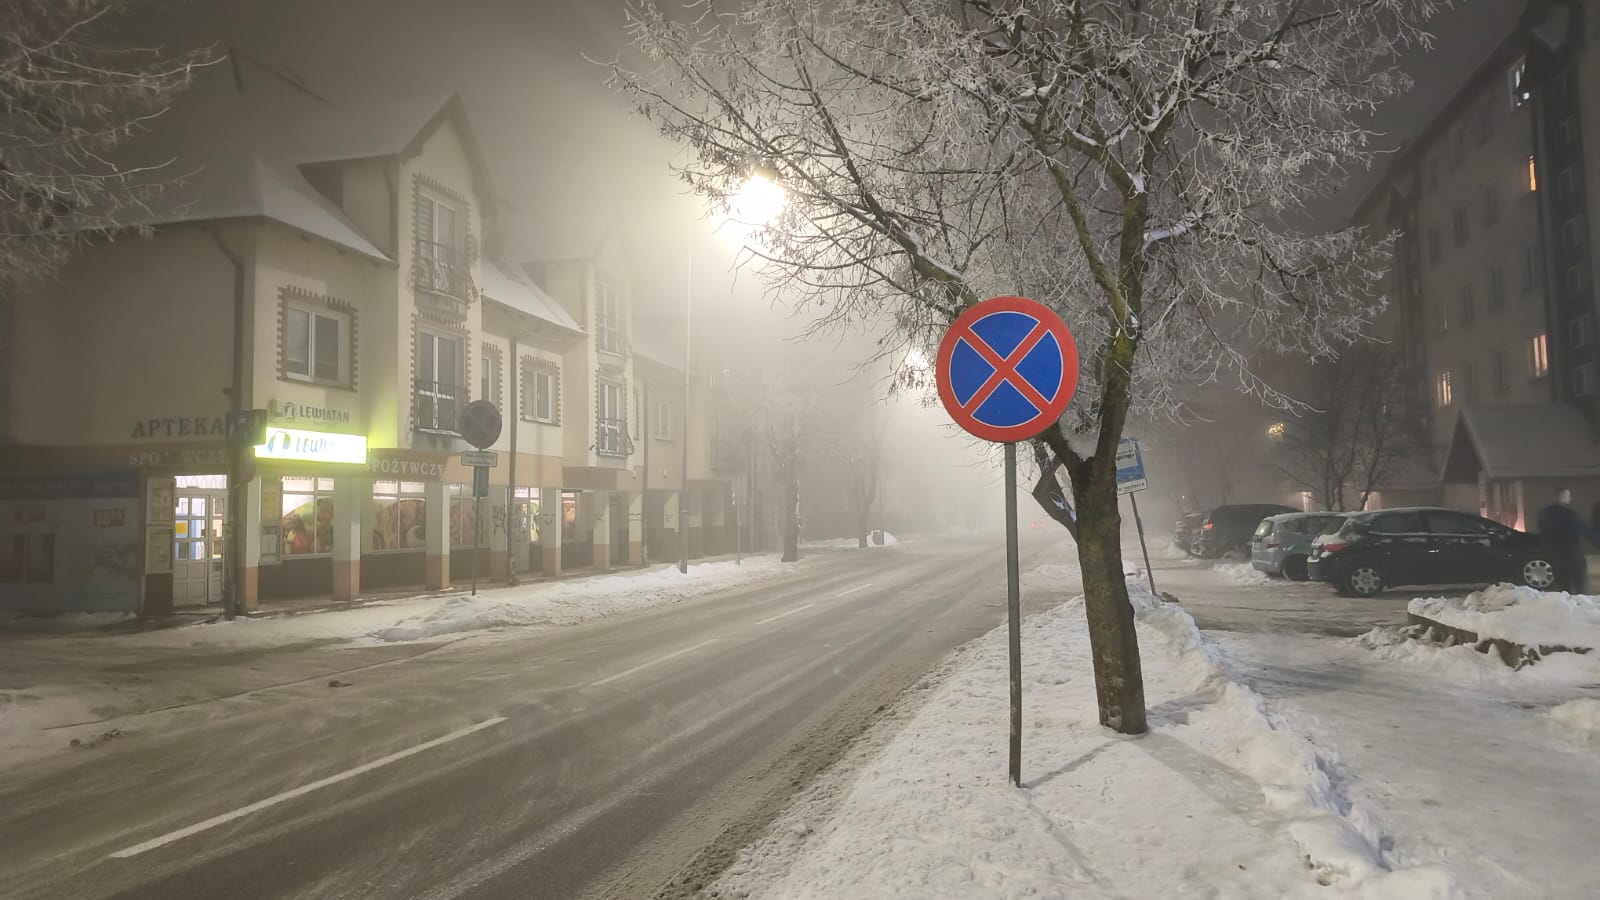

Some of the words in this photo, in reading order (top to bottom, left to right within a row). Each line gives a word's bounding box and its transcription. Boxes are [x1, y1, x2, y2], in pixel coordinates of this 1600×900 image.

[299, 405, 350, 424] LEWIATAN
[131, 416, 225, 438] APTEKA
[128, 447, 226, 466] SPOWCZY
[367, 457, 445, 477] POŻYWCZY
